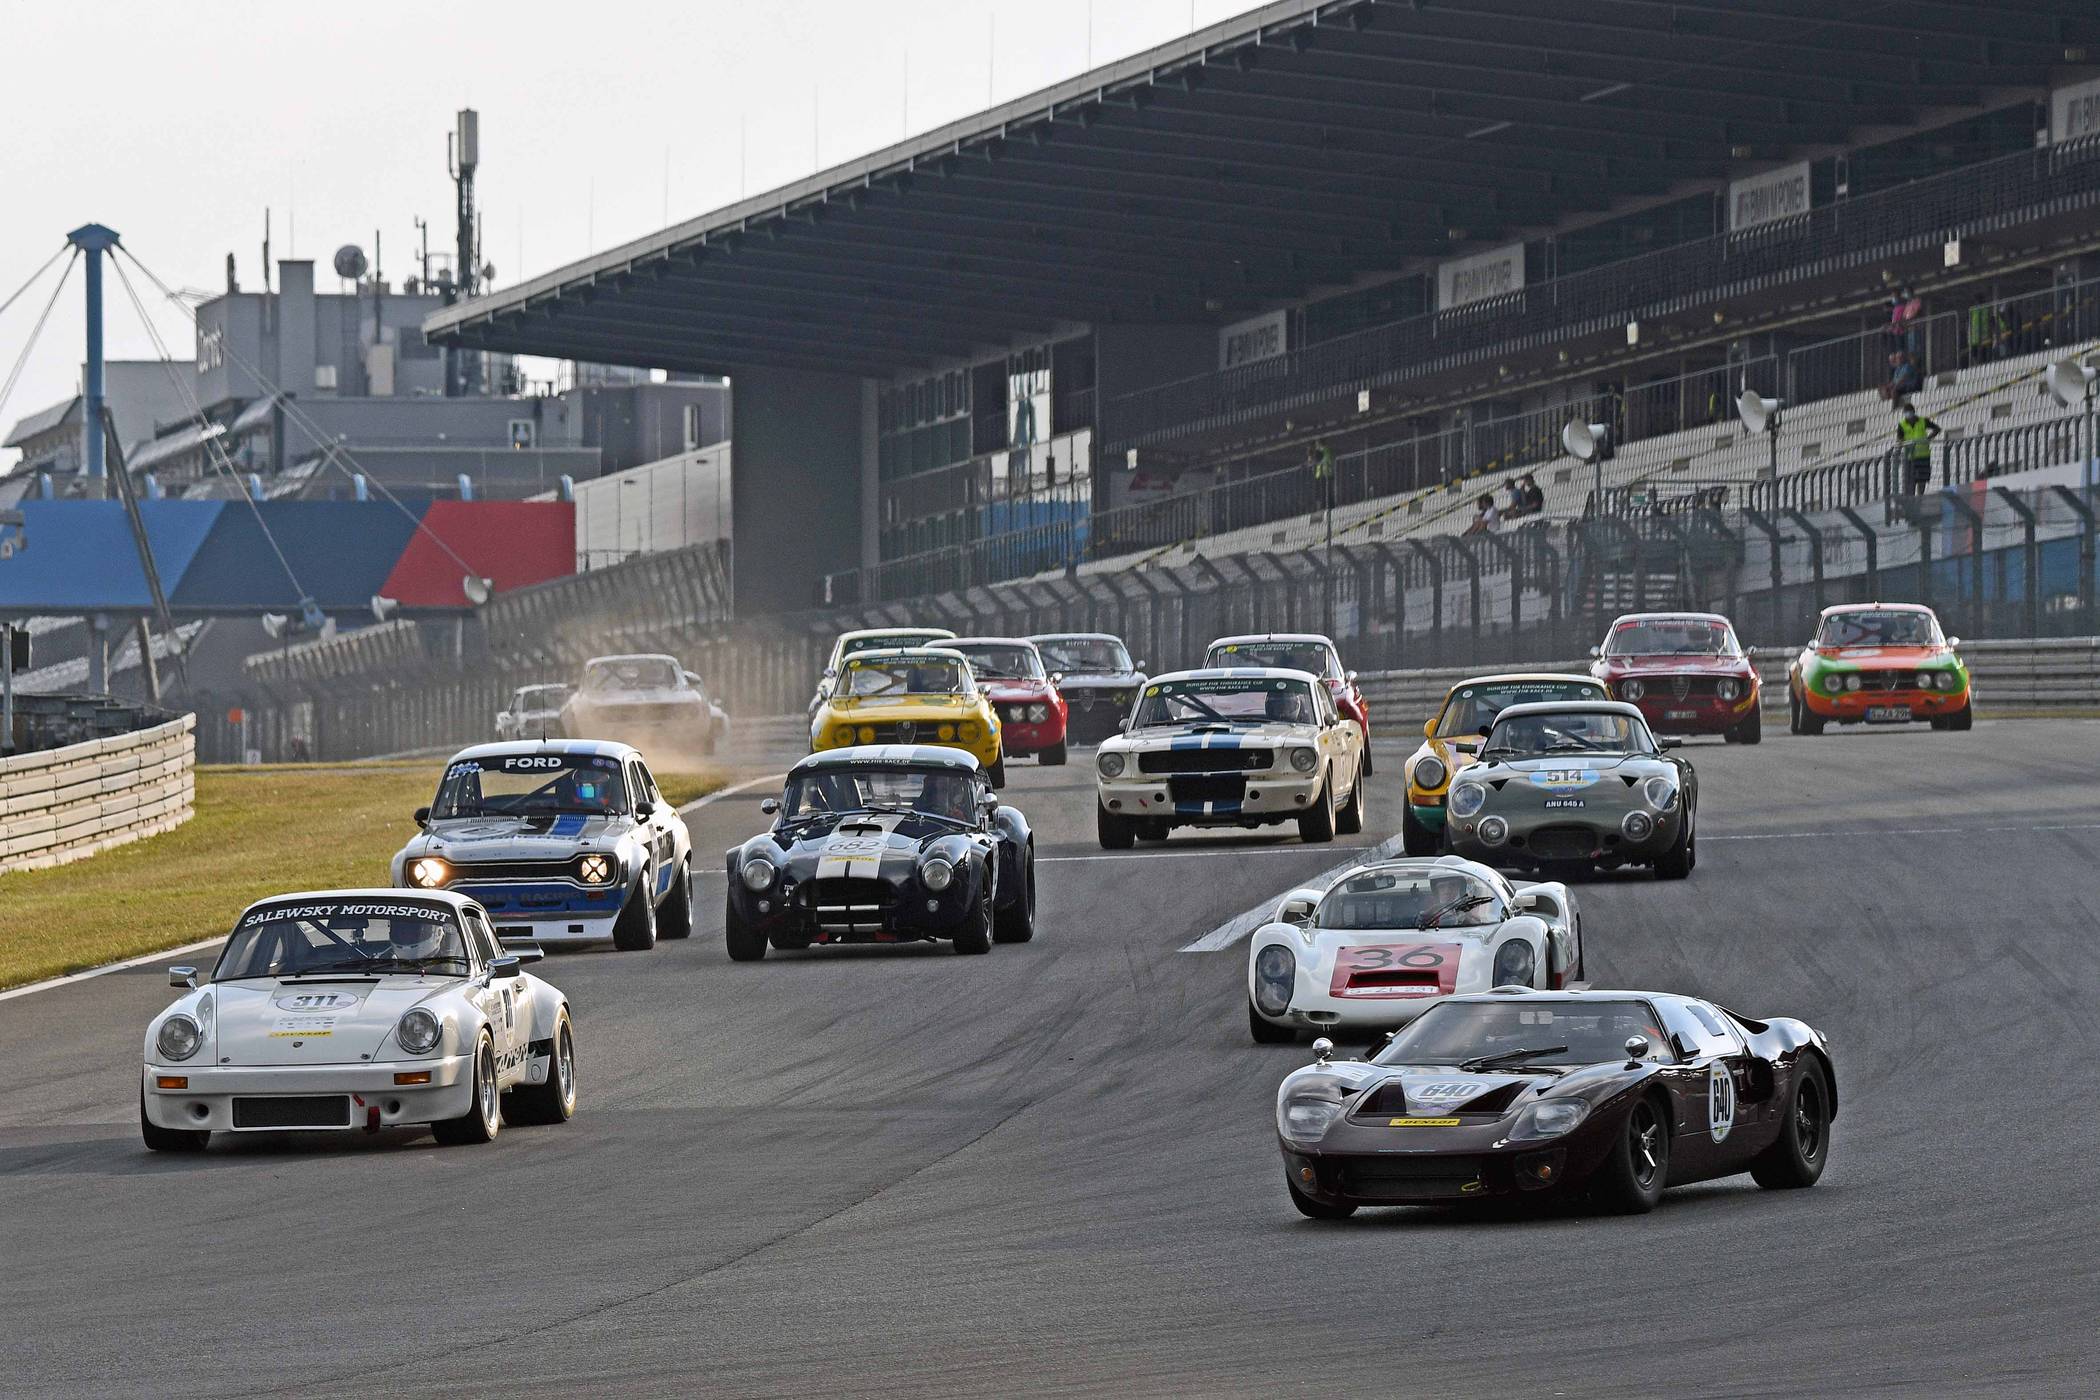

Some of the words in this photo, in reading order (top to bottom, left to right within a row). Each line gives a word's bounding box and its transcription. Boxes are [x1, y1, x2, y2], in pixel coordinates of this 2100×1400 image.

[1750, 186, 1769, 223] BMW
[1778, 176, 1804, 215] POWER
[505, 757, 562, 769] FORD
[1547, 769, 1582, 781] 514
[1546, 800, 1561, 808] ANU
[1579, 800, 1584, 808] A
[828, 841, 880, 851] 682
[244, 905, 337, 928] SALEWSKY
[339, 904, 451, 923] MOTORSPORT
[1348, 946, 1444, 970] 36
[292, 995, 339, 1007] 311
[1419, 1084, 1481, 1097] 640
[1713, 1077, 1731, 1123] 640
